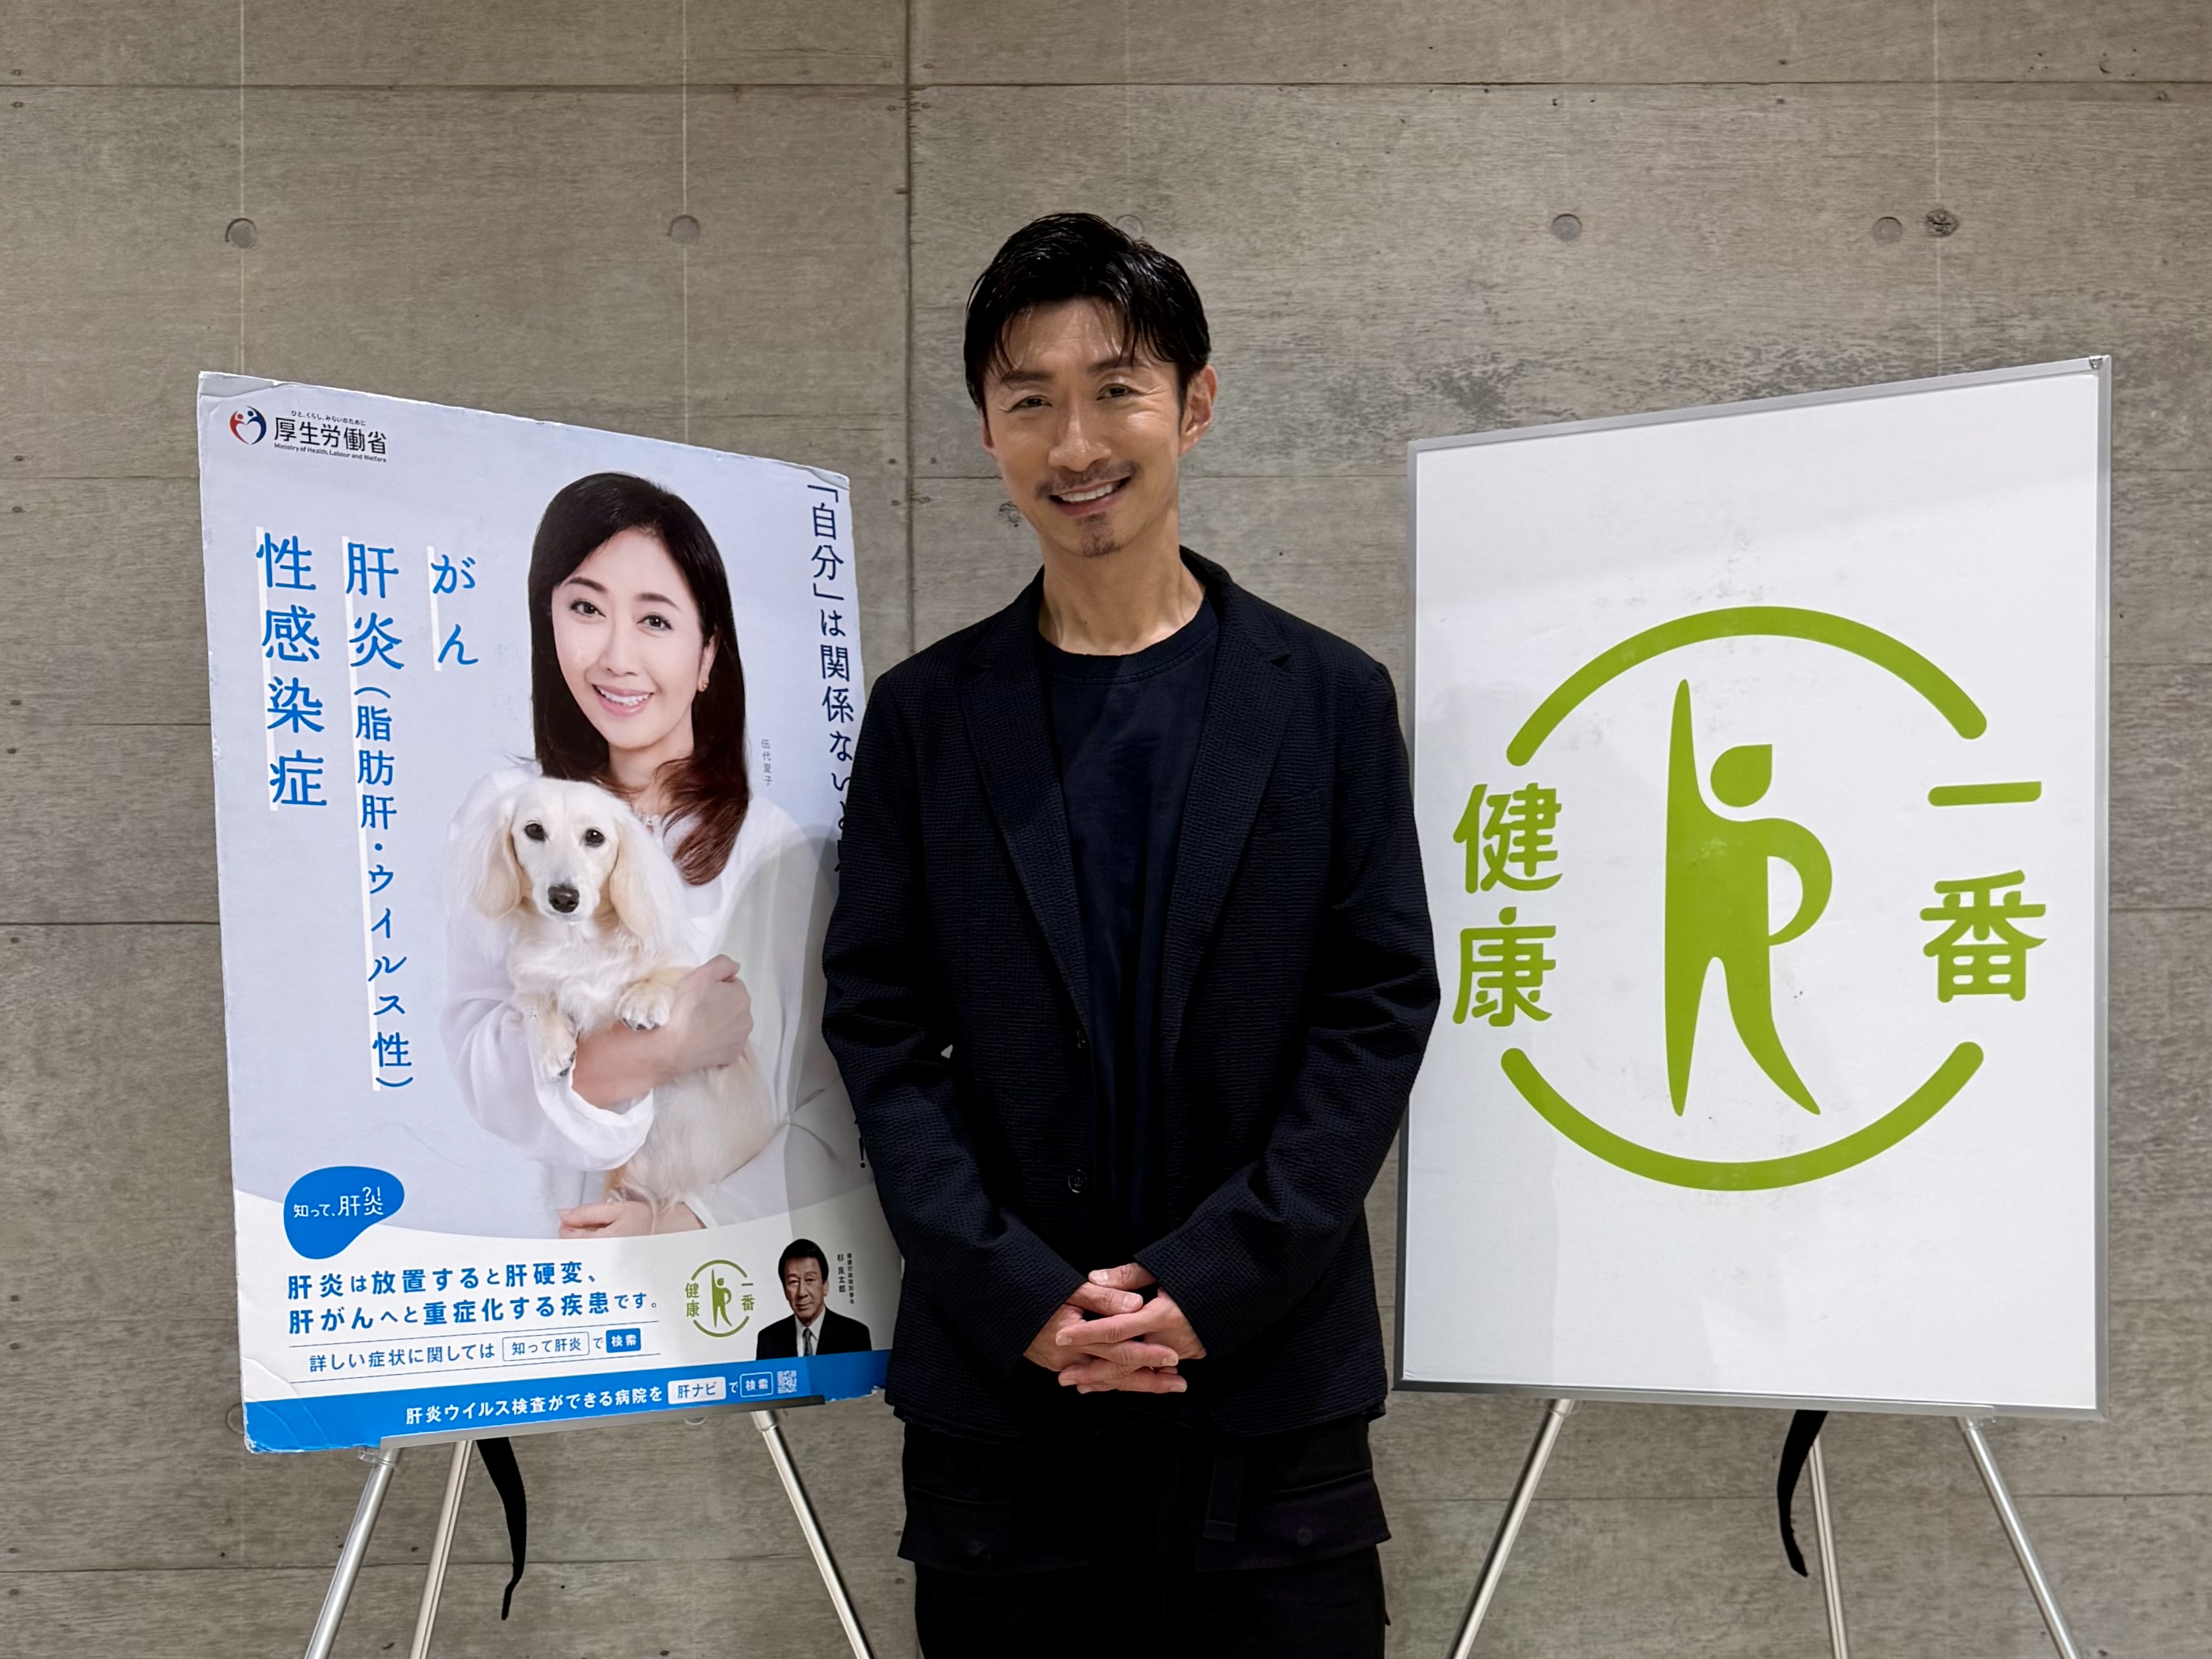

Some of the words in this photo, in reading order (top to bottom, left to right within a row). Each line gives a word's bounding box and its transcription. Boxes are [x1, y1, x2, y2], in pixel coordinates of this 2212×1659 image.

[274, 417, 386, 455] 厚生労働省
[274, 443, 299, 452] Ministry
[430, 554, 478, 666] がん
[256, 532, 327, 806] 性感染症
[1452, 782, 1563, 1027] 健康
[1920, 781, 2047, 1003] 一番
[288, 1261, 595, 1300] 肝炎は放置すると肝硬変、
[289, 1292, 657, 1334] 肝がんへと重症化する疾患です。
[678, 1382, 717, 1399] 肝ナビ
